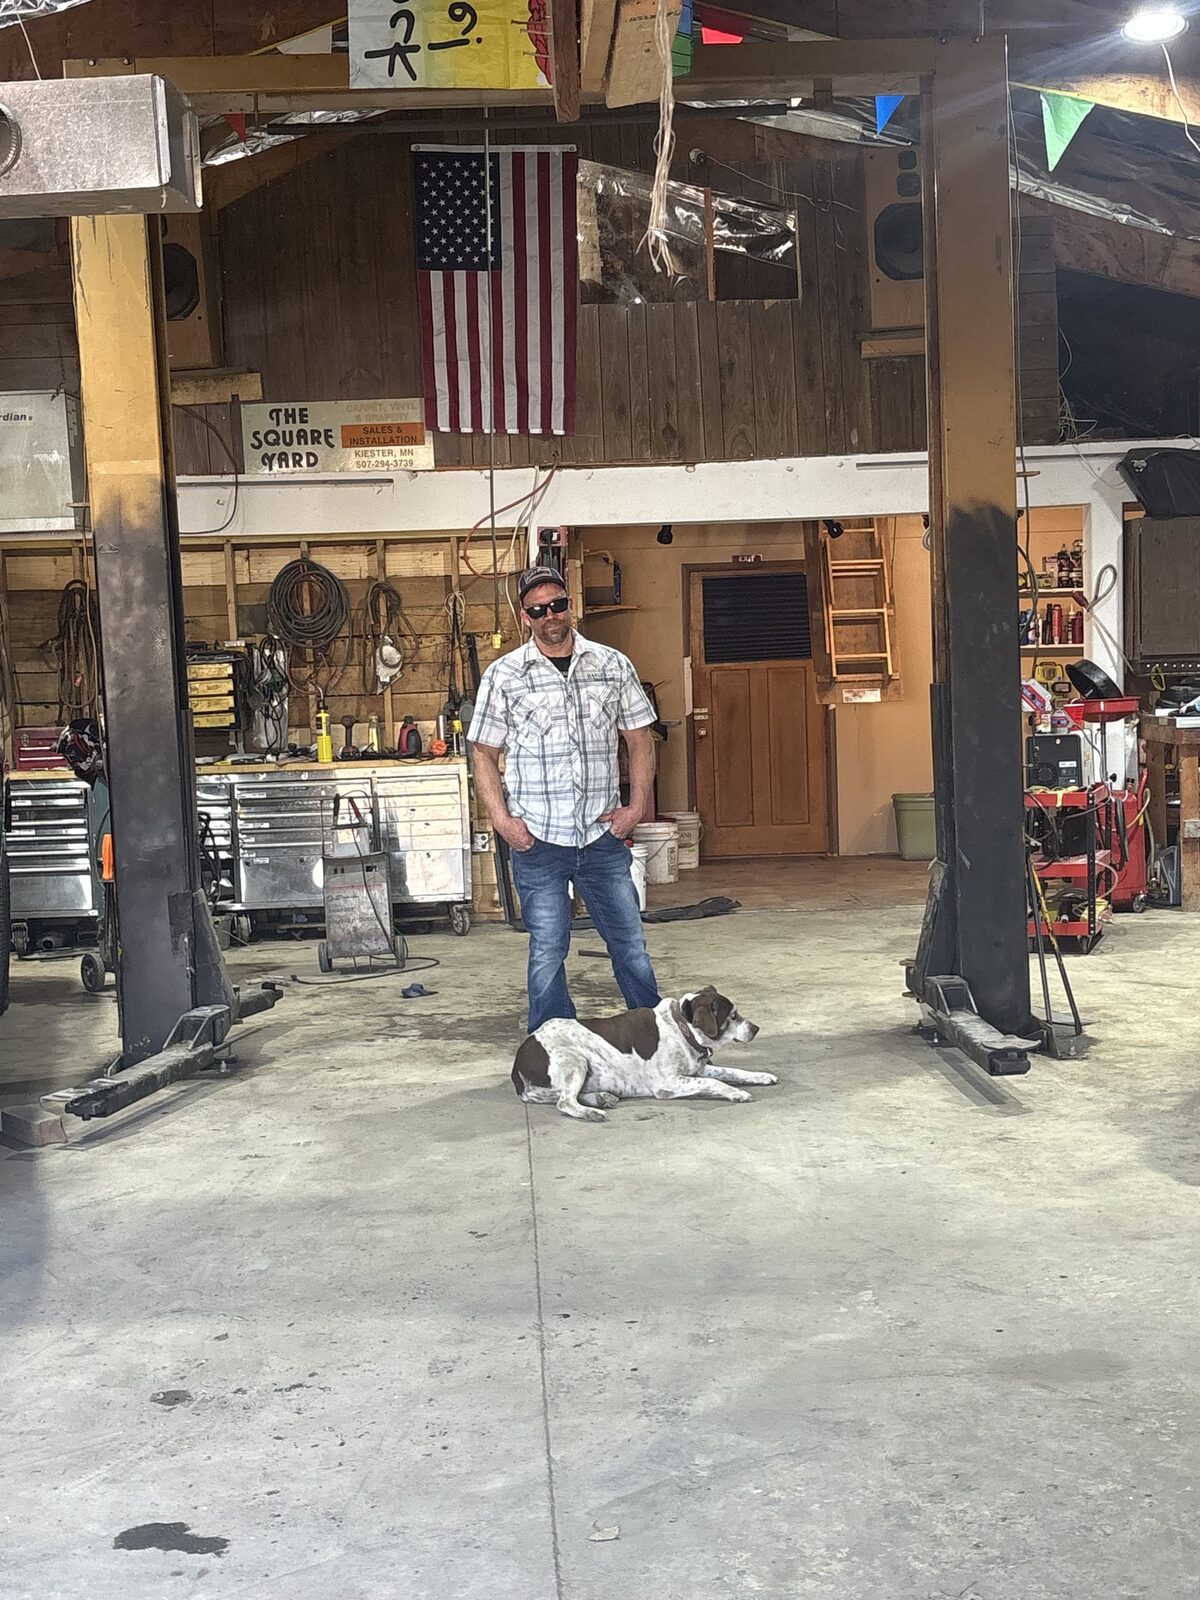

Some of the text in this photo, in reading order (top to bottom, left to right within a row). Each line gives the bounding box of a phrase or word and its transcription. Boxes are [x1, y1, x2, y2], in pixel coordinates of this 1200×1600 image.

[268, 407, 309, 427] THE
[362, 425, 403, 435] SALES &
[250, 428, 335, 450] SQUARE
[349, 435, 418, 446] INSTALLATION
[354, 448, 414, 458] KIESTER, MN
[260, 451, 319, 472] YARD
[356, 459, 414, 469] 507-294-3739
